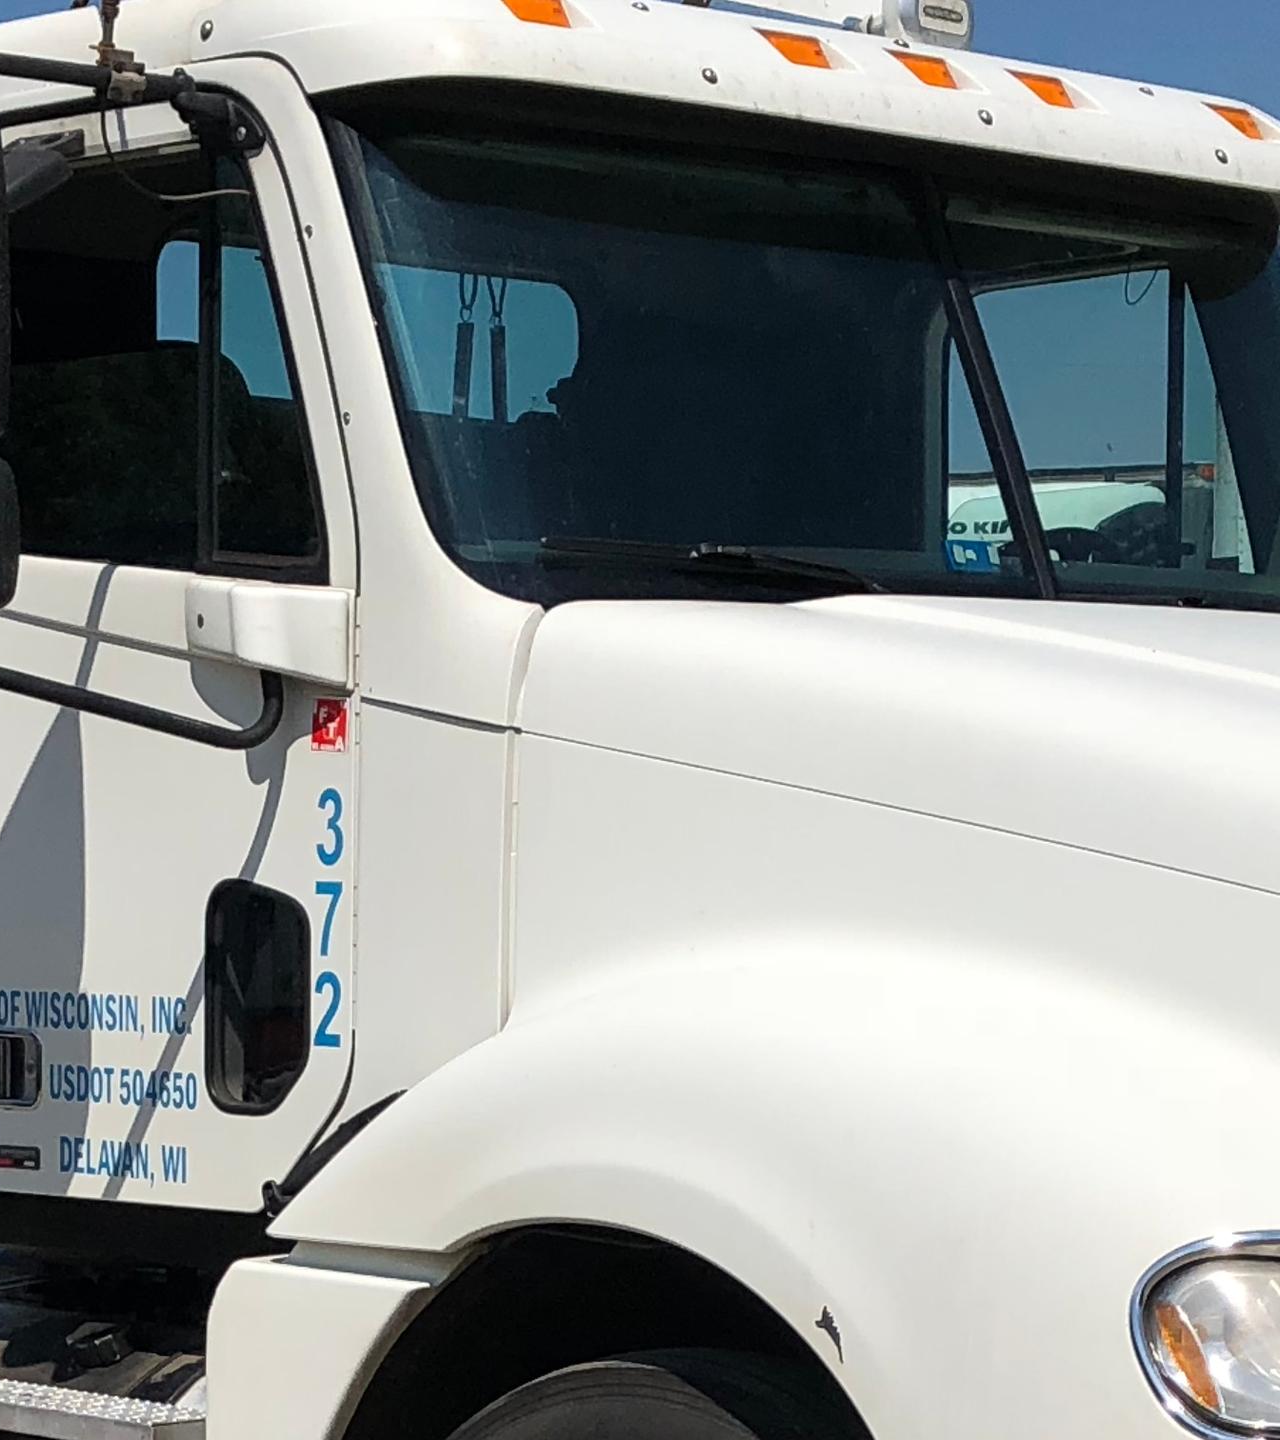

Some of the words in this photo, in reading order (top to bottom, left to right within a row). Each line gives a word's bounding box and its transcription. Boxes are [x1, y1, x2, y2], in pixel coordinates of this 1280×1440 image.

[25, 991, 146, 1040] WISCONSIN,
[152, 995, 193, 1035] INC.
[49, 1064, 114, 1104] USDOT
[119, 1068, 198, 1110] 504650
[59, 1135, 156, 1188] DELAVAN,
[161, 1145, 187, 1183] WI
